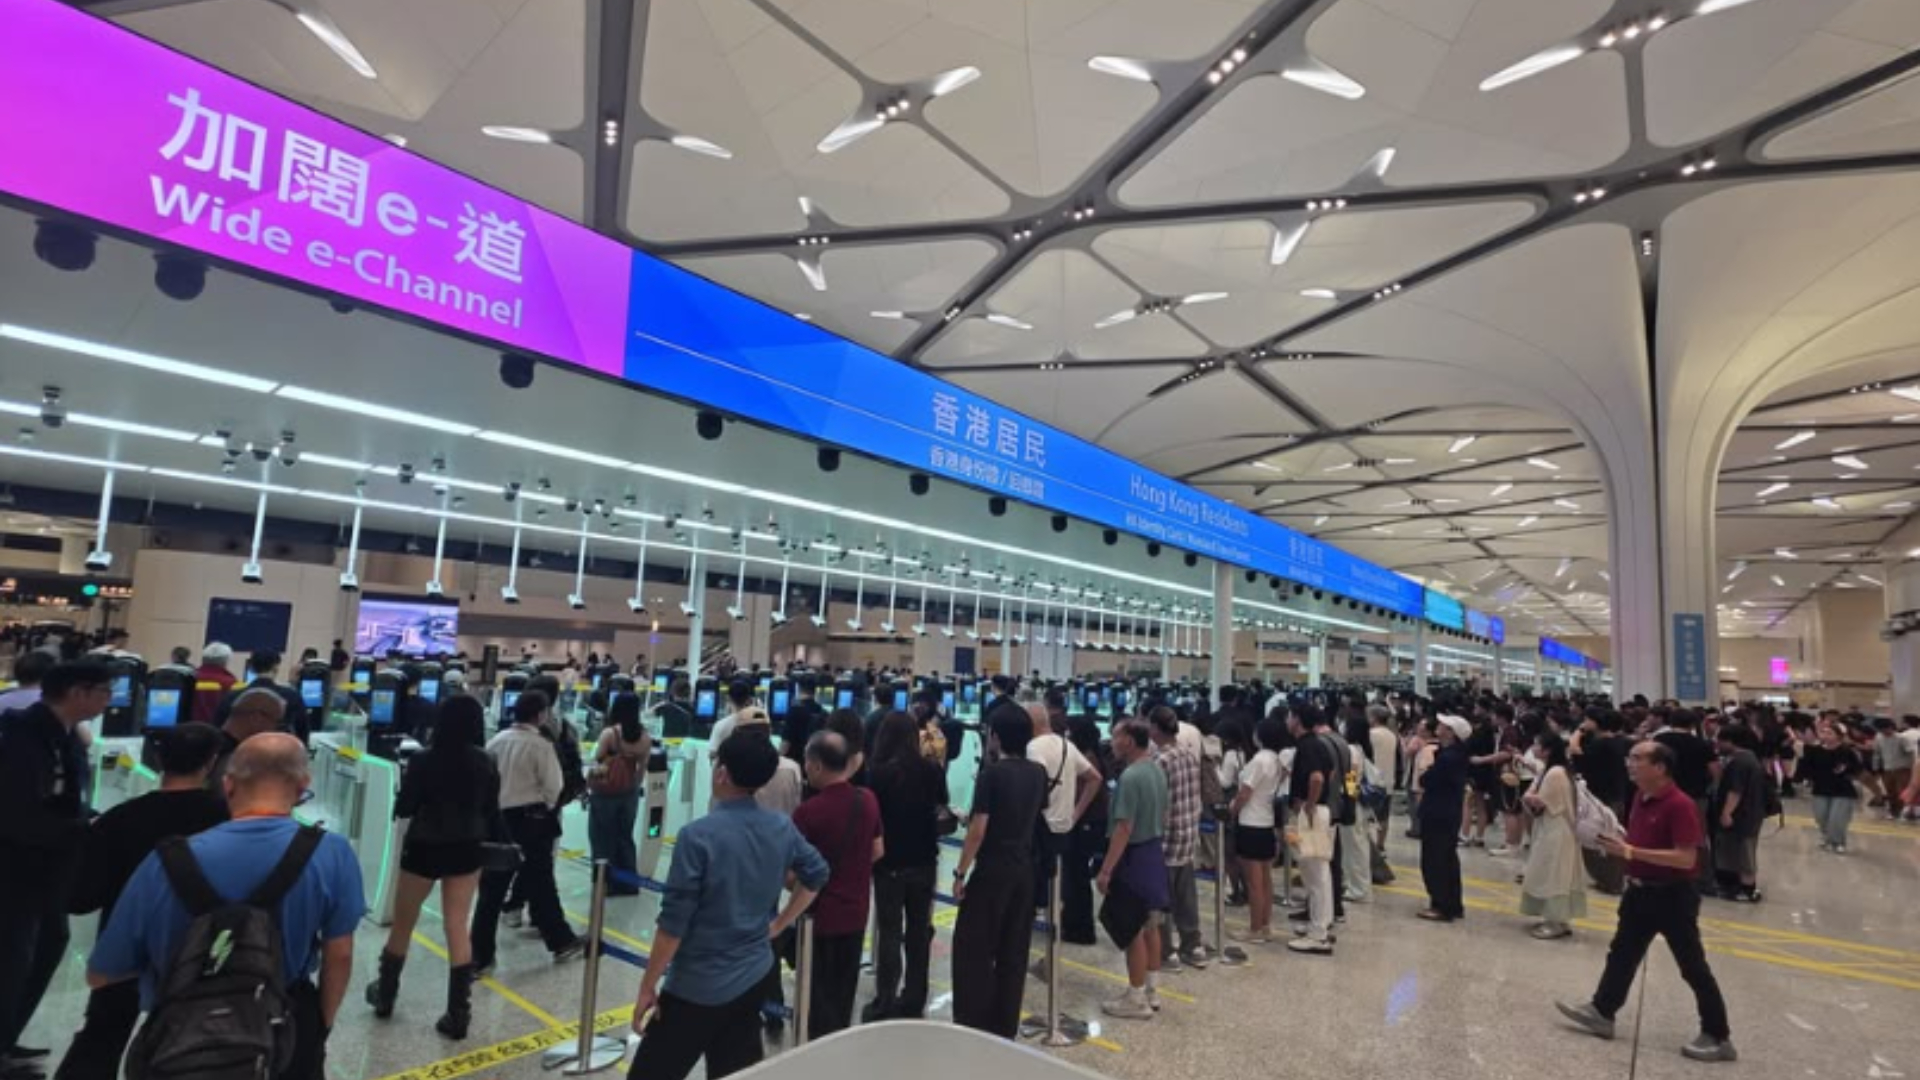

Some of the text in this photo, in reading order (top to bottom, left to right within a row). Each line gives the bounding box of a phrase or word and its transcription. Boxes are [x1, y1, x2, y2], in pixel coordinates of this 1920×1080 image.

[160, 86, 526, 284] 加闊e-道
[149, 175, 523, 329] Wide e-Channel
[932, 391, 1046, 468] 香港居民
[1130, 473, 1166, 512] Hong
[1168, 489, 1199, 524] Kong
